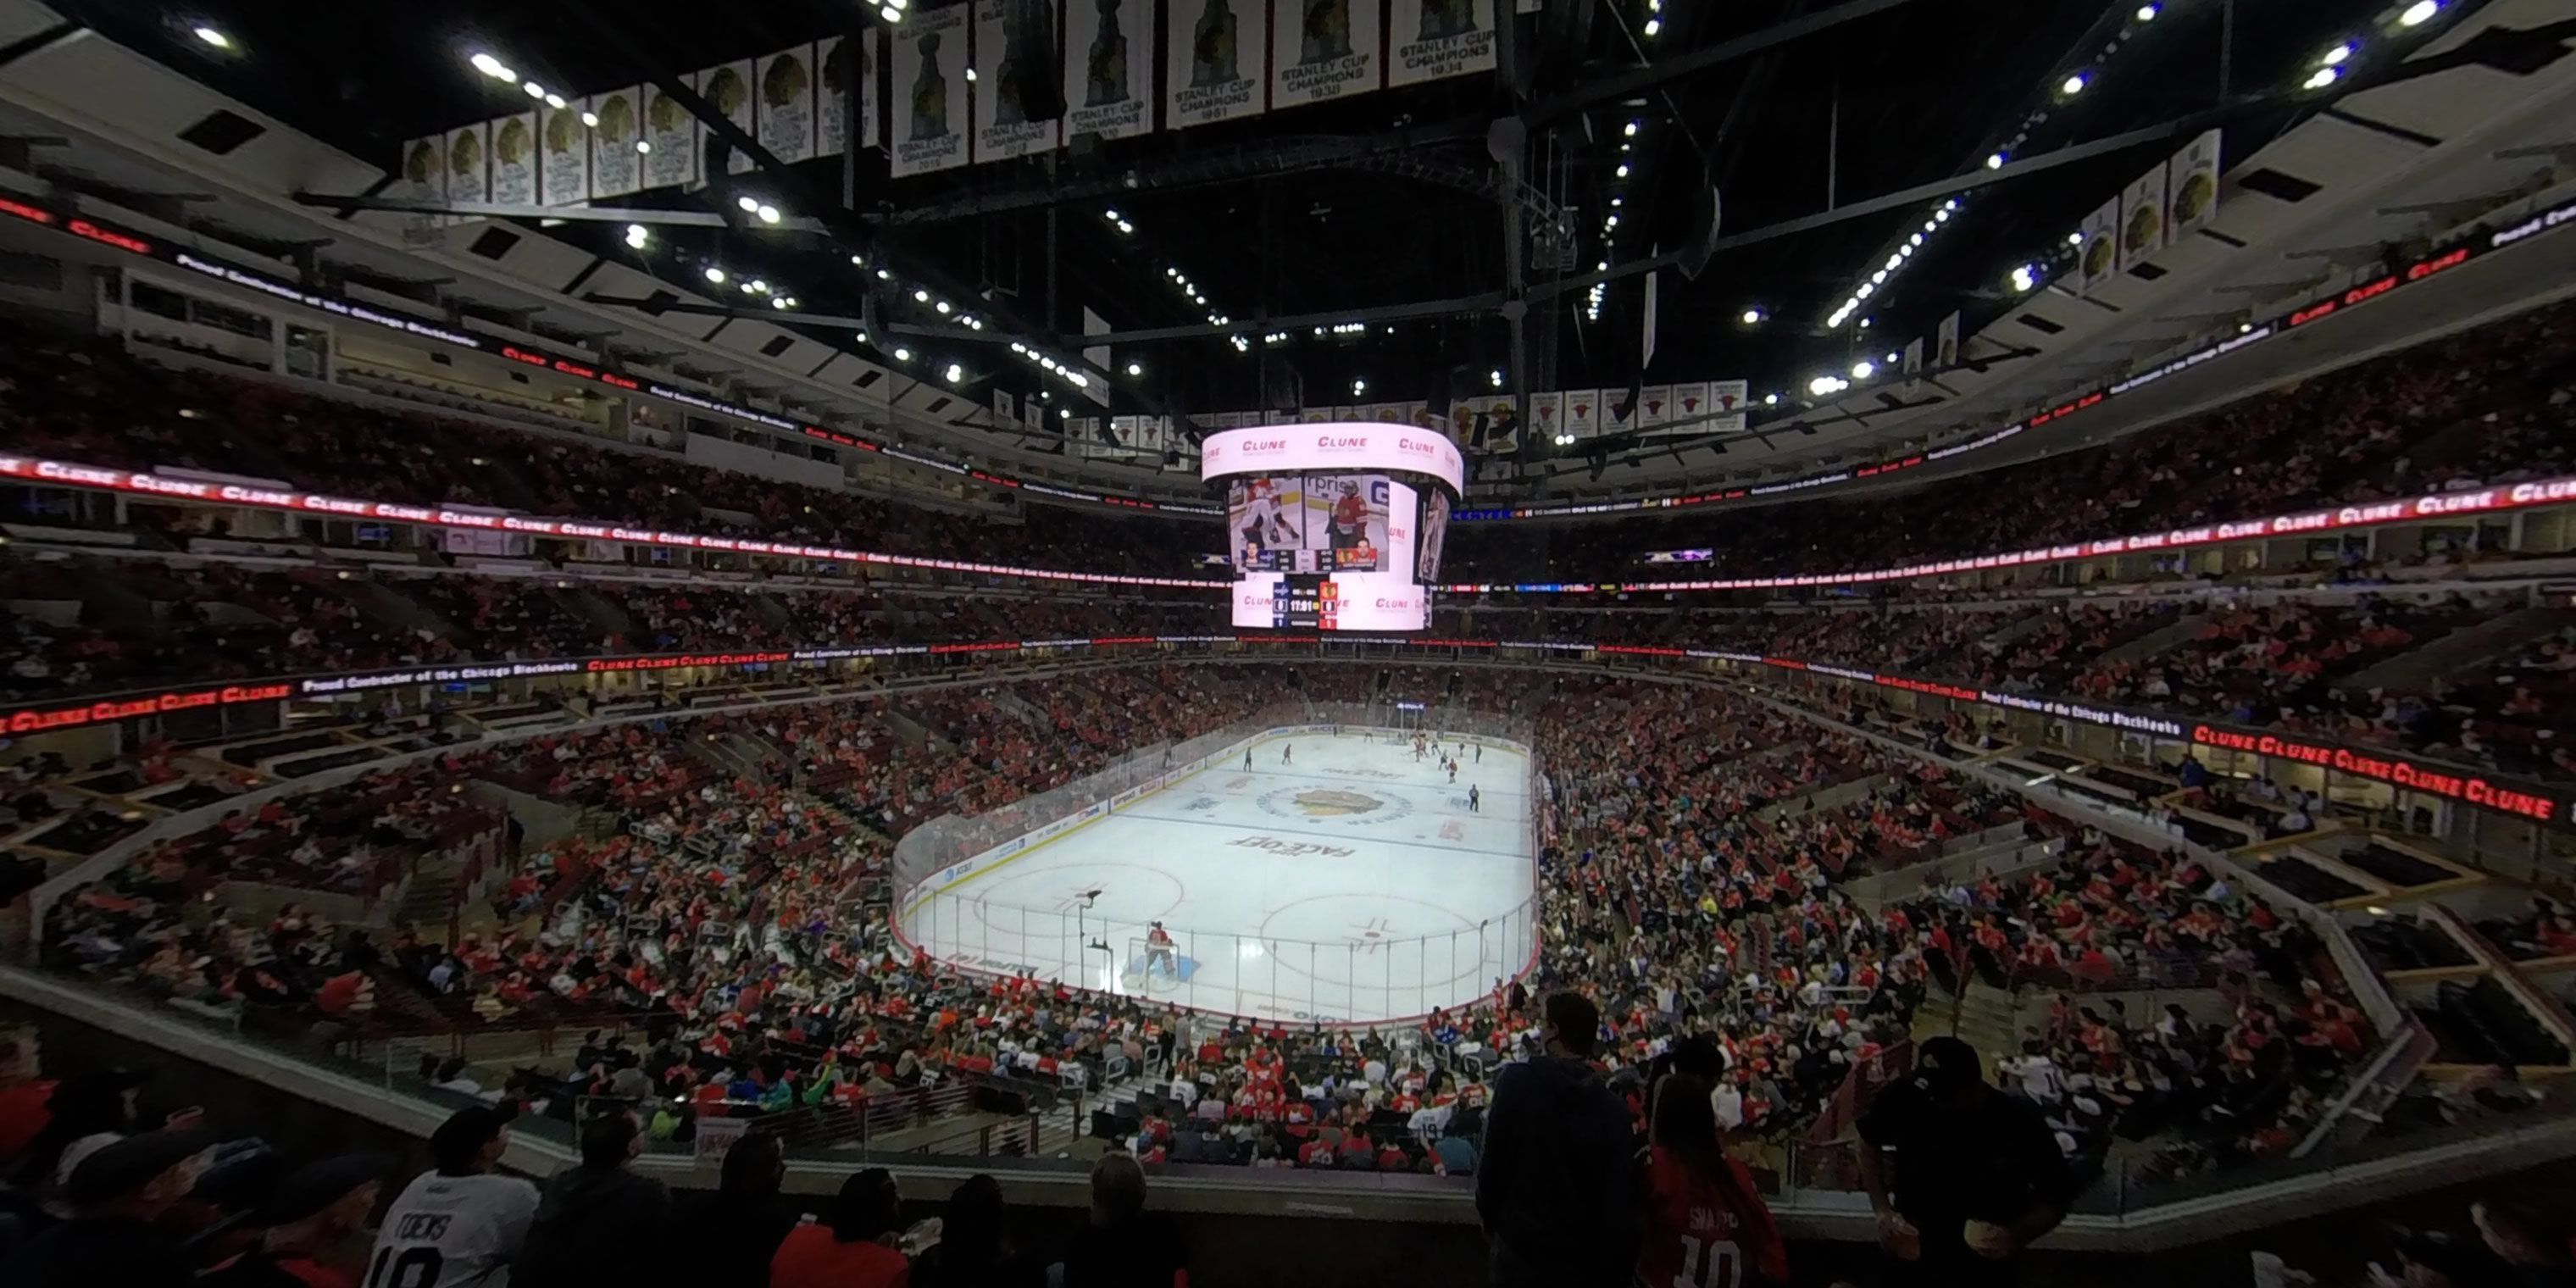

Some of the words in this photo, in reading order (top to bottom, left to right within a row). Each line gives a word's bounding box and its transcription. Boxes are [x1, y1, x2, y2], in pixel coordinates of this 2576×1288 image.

[1400, 37, 1457, 58] STANLEY
[1465, 30, 1496, 46] CUP
[1280, 61, 1336, 81] STANLEY
[1341, 53, 1369, 69] CUP
[1405, 45, 1490, 69] CHAMPIONS
[1174, 85, 1224, 103] STANLEY
[1230, 78, 1256, 92] CUP
[1287, 68, 1364, 92] CHAMPIONS
[1070, 106, 1115, 123] STANLEY
[1120, 101, 1145, 114] CUP
[1179, 91, 1251, 113] CHAMPIONS
[1074, 114, 1140, 132] CHAMPIONS
[1242, 440, 1286, 452] CLUNE
[1318, 436, 1368, 447] CLUNE
[1399, 438, 1435, 454] CLUNE
[587, 658, 634, 671] CLUNE
[636, 658, 679, 669] CLUNE
[2194, 724, 2256, 750] CLUNE
[2258, 736, 2330, 763] CLUNE
[2334, 748, 2391, 780] CLUNE
[2393, 763, 2462, 797] CLUNE
[2466, 779, 2554, 819] CLUNE
